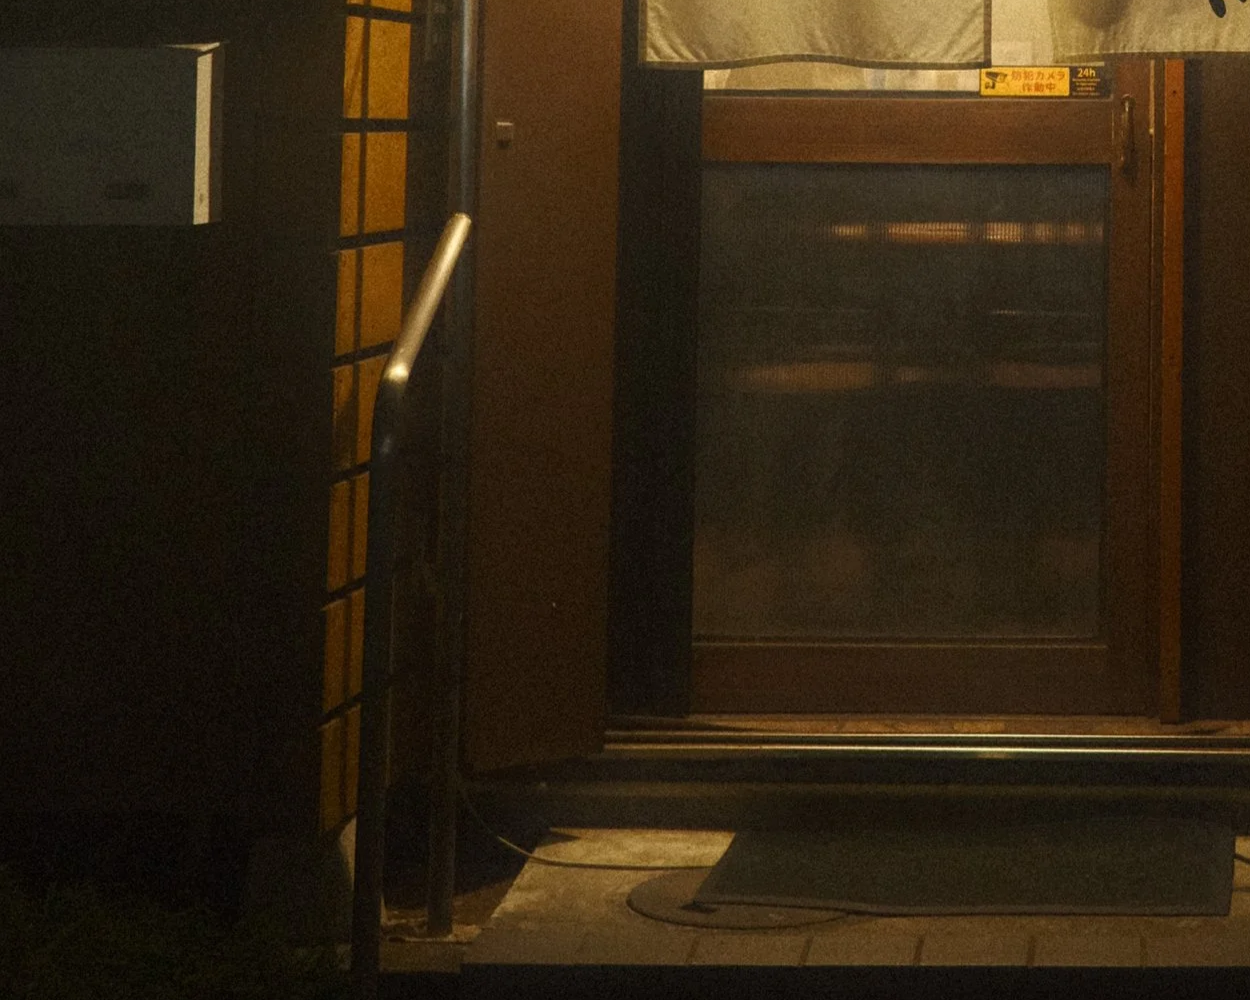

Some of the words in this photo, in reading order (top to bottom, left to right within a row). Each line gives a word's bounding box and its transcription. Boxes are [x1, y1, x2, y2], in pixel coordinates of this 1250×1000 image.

[1011, 70, 1066, 81] 防犯カメラ
[1077, 67, 1096, 78] 24h
[1022, 82, 1057, 93] 作動中
